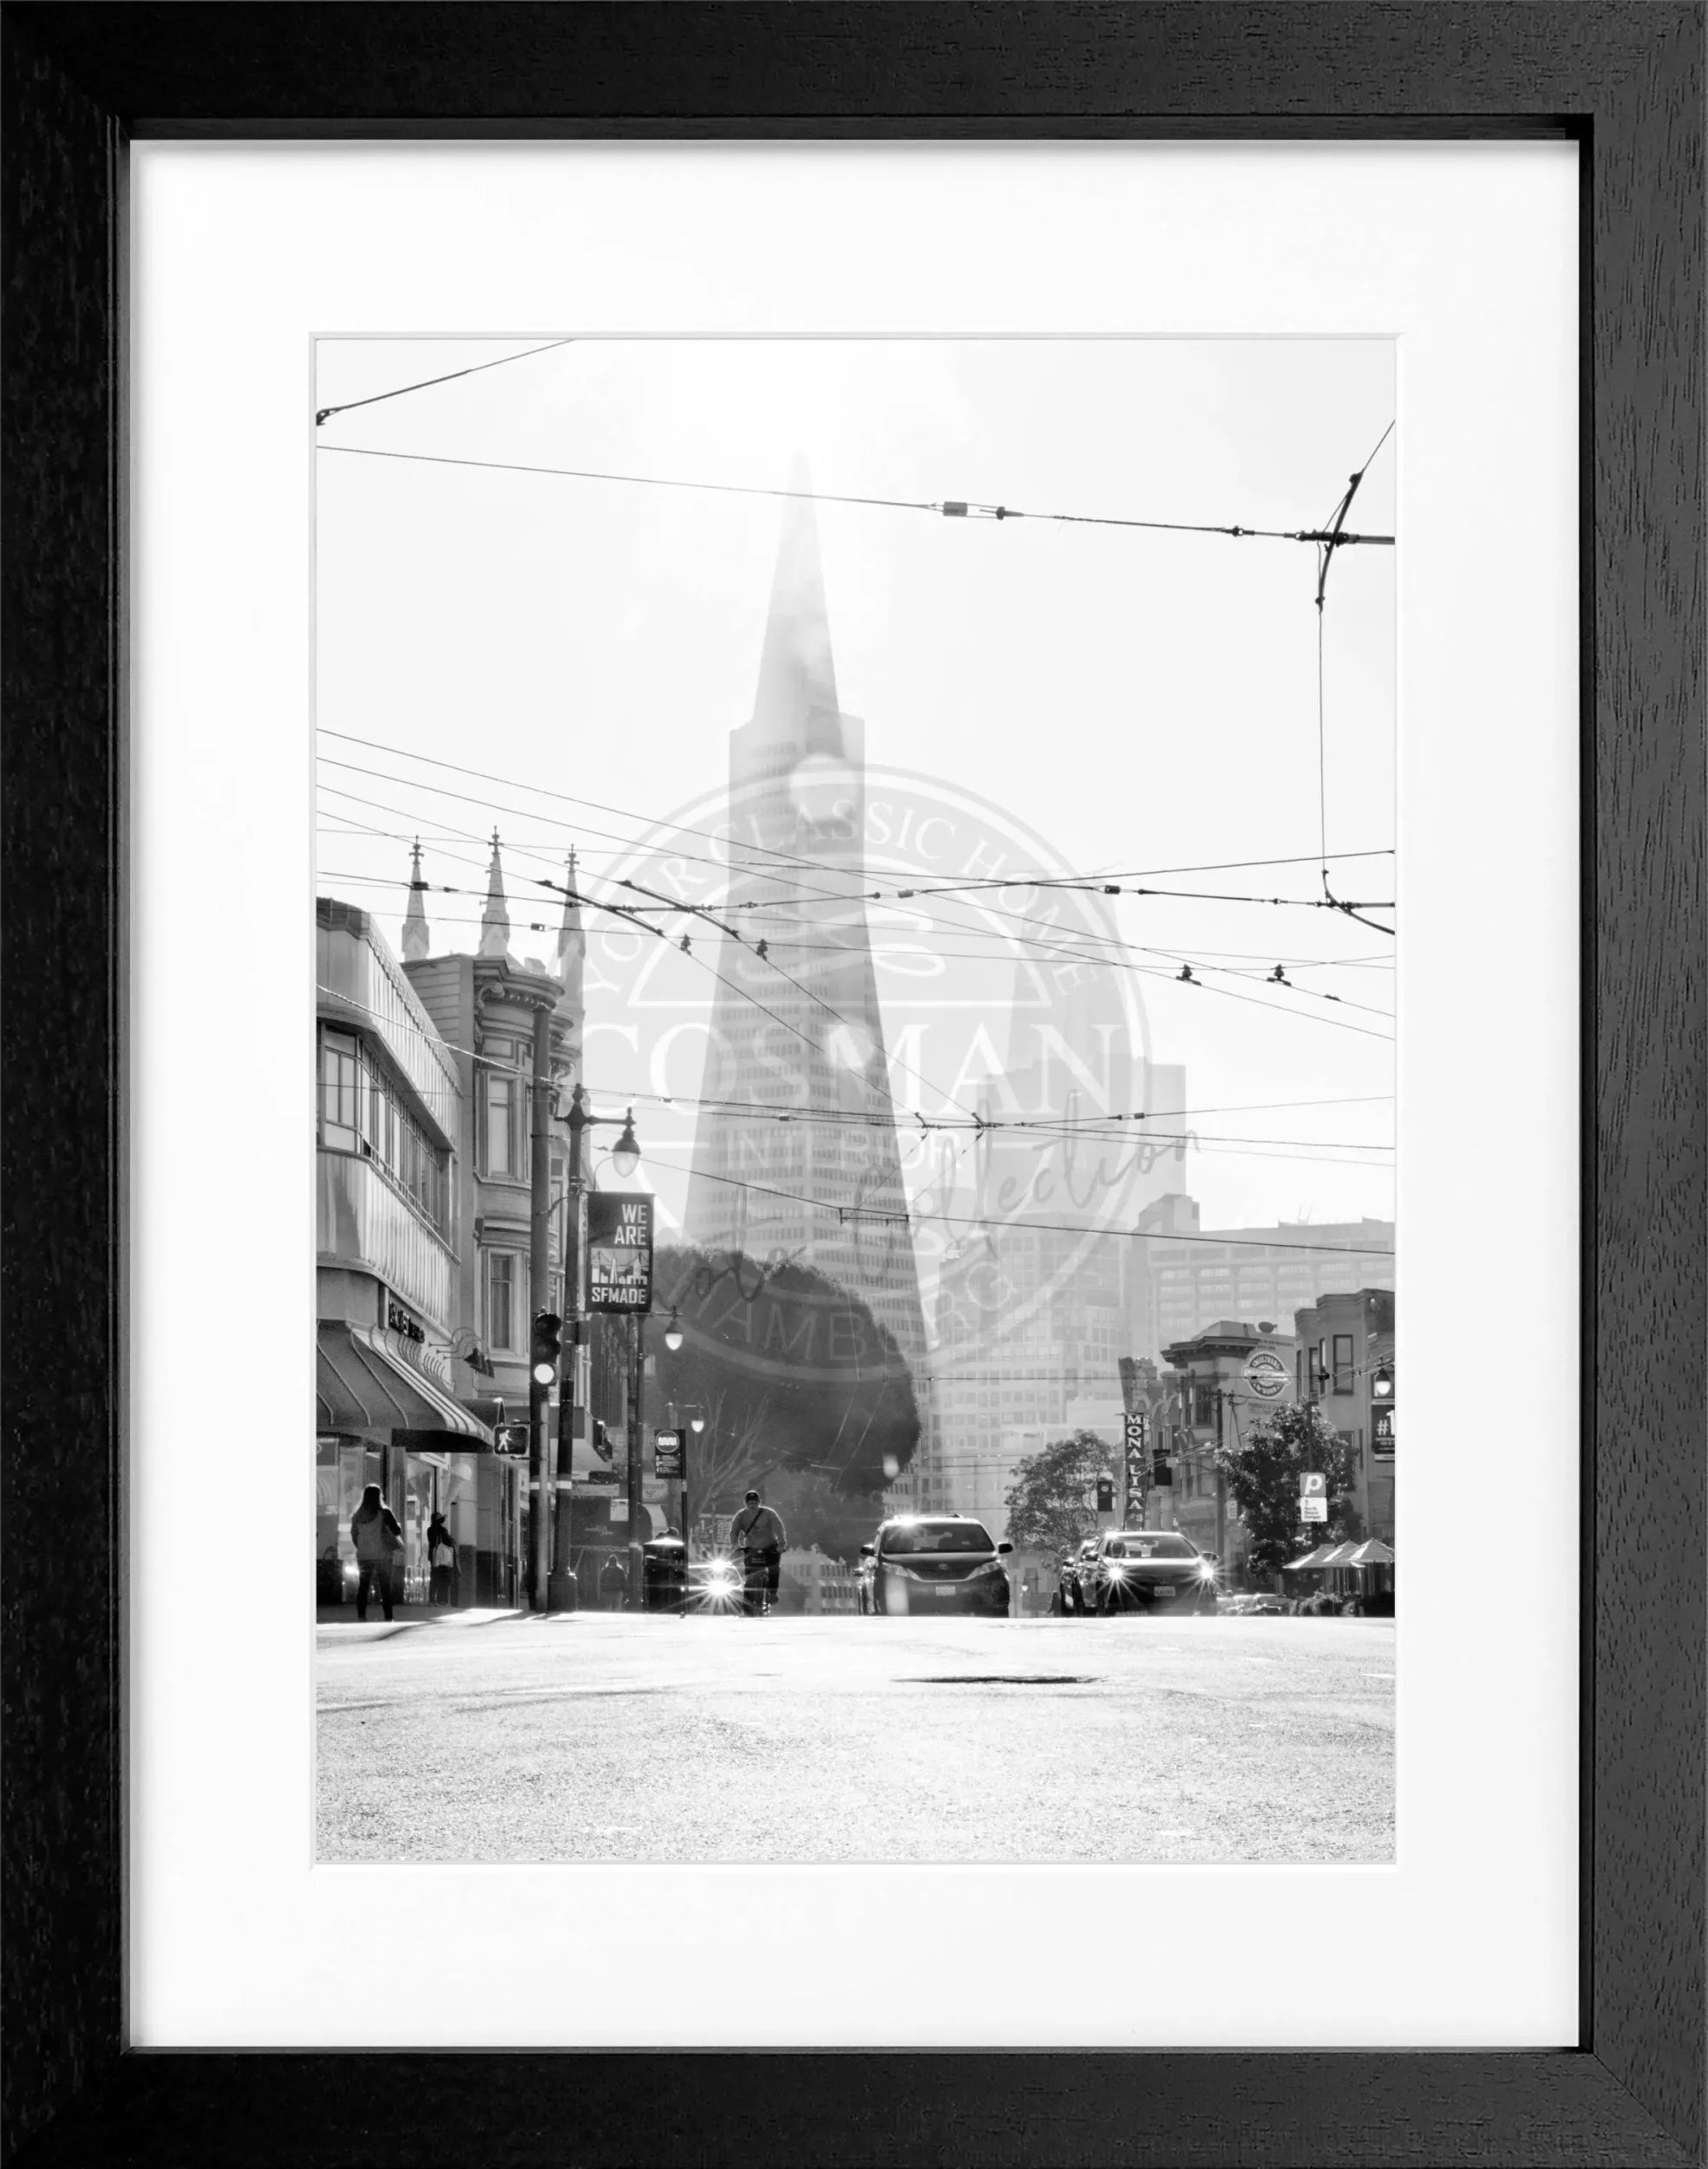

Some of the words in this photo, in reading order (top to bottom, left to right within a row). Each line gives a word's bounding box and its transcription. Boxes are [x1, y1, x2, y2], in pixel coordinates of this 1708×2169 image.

[621, 1203, 647, 1224] WE
[614, 1225, 646, 1246] ARE
[592, 1287, 646, 1305] SFMADE
[1127, 1414, 1143, 1458] MONA
[1129, 1465, 1144, 1510] LISA
